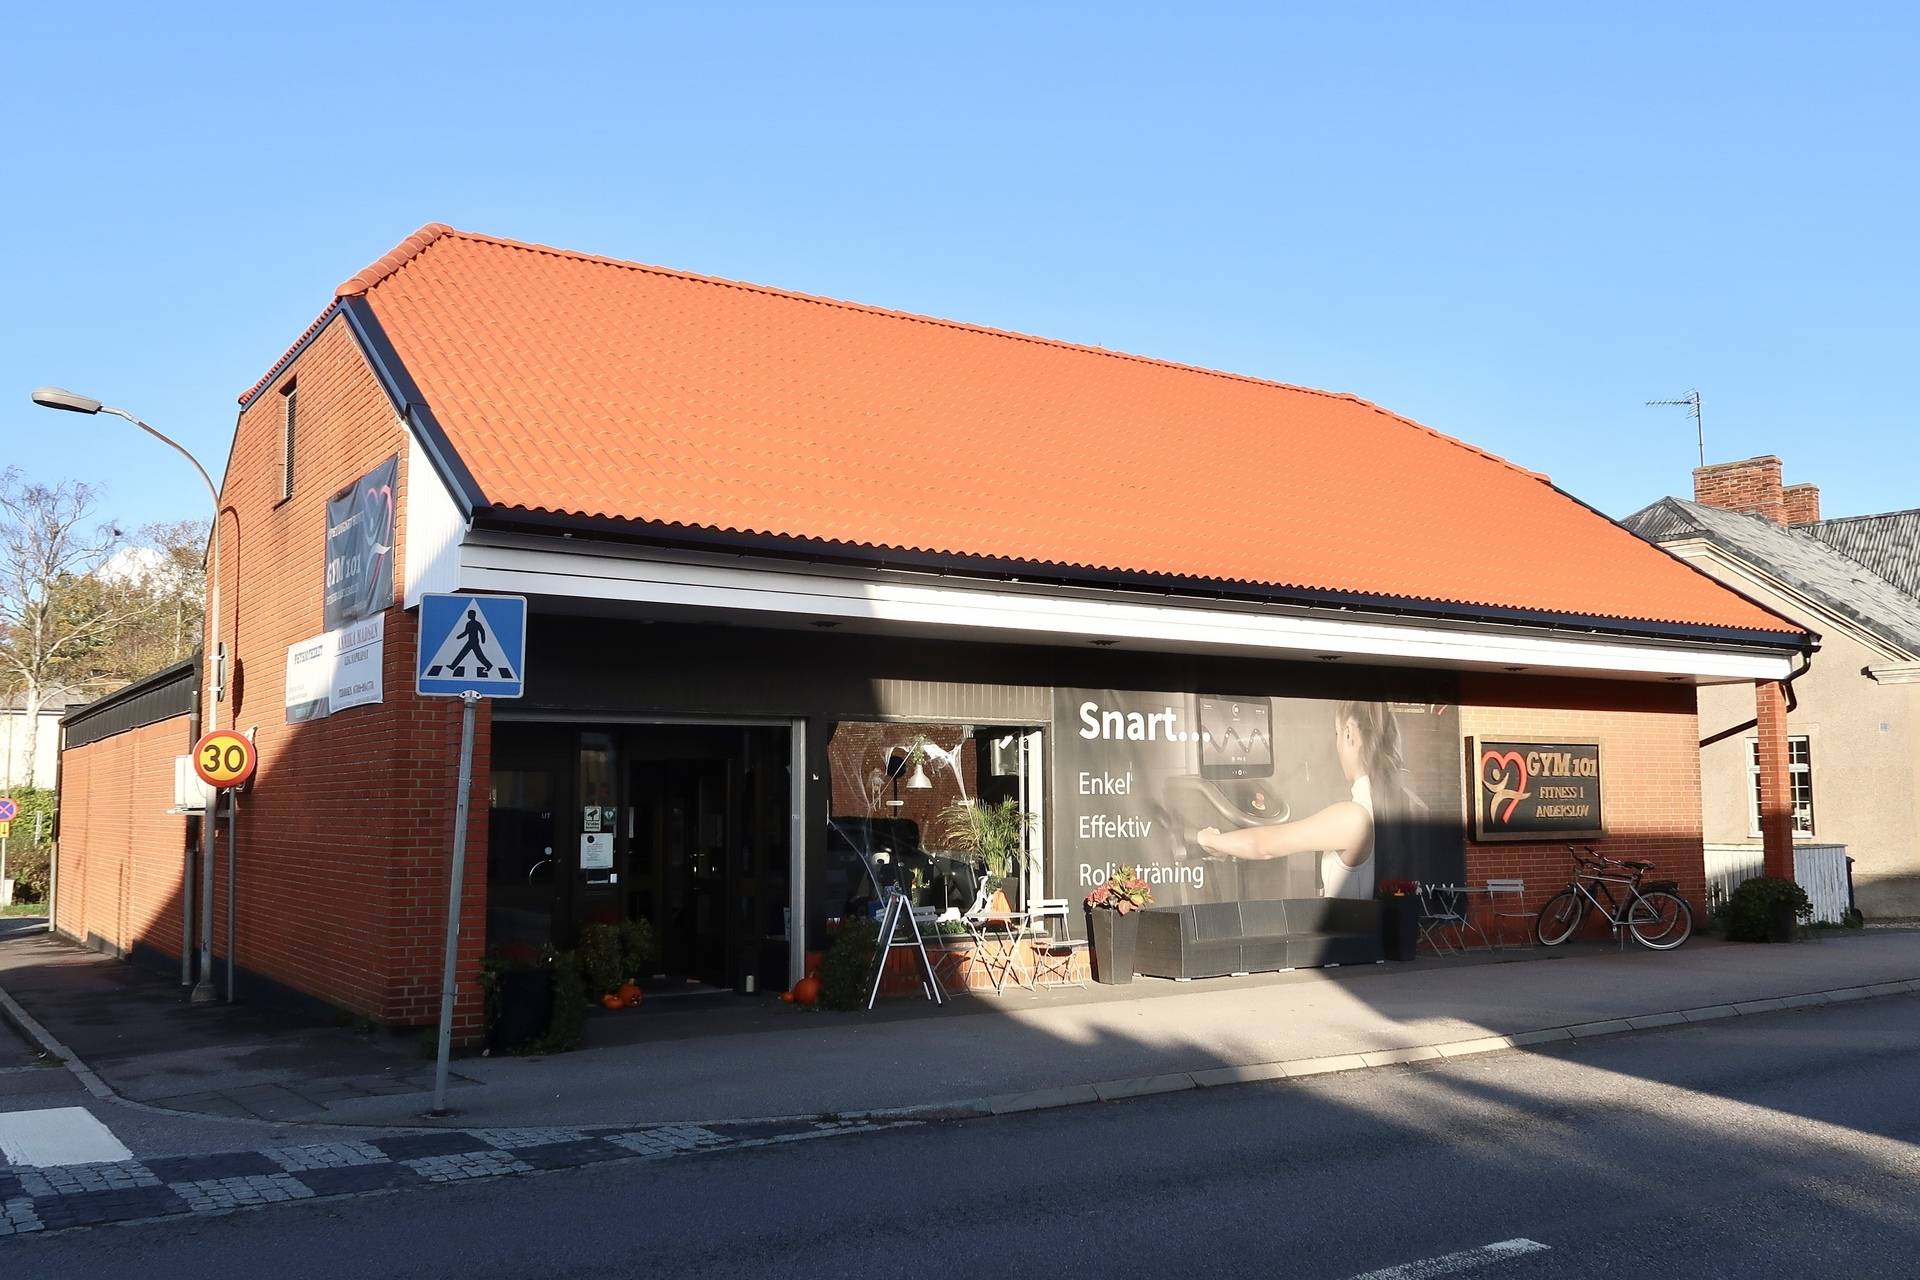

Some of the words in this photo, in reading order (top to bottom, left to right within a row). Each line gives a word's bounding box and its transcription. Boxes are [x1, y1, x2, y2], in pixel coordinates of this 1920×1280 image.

[345, 553, 361, 578] 101
[1079, 701, 1211, 742] Snart...
[203, 744, 245, 773] 30
[1526, 751, 1571, 777] GYM
[1572, 757, 1598, 777] 101
[1079, 771, 1131, 795] Enkel
[1539, 786, 1578, 799] FITNESS
[1079, 815, 1152, 839] Effektiv
[1079, 862, 1118, 887] Roli
[1135, 862, 1204, 889] träning
